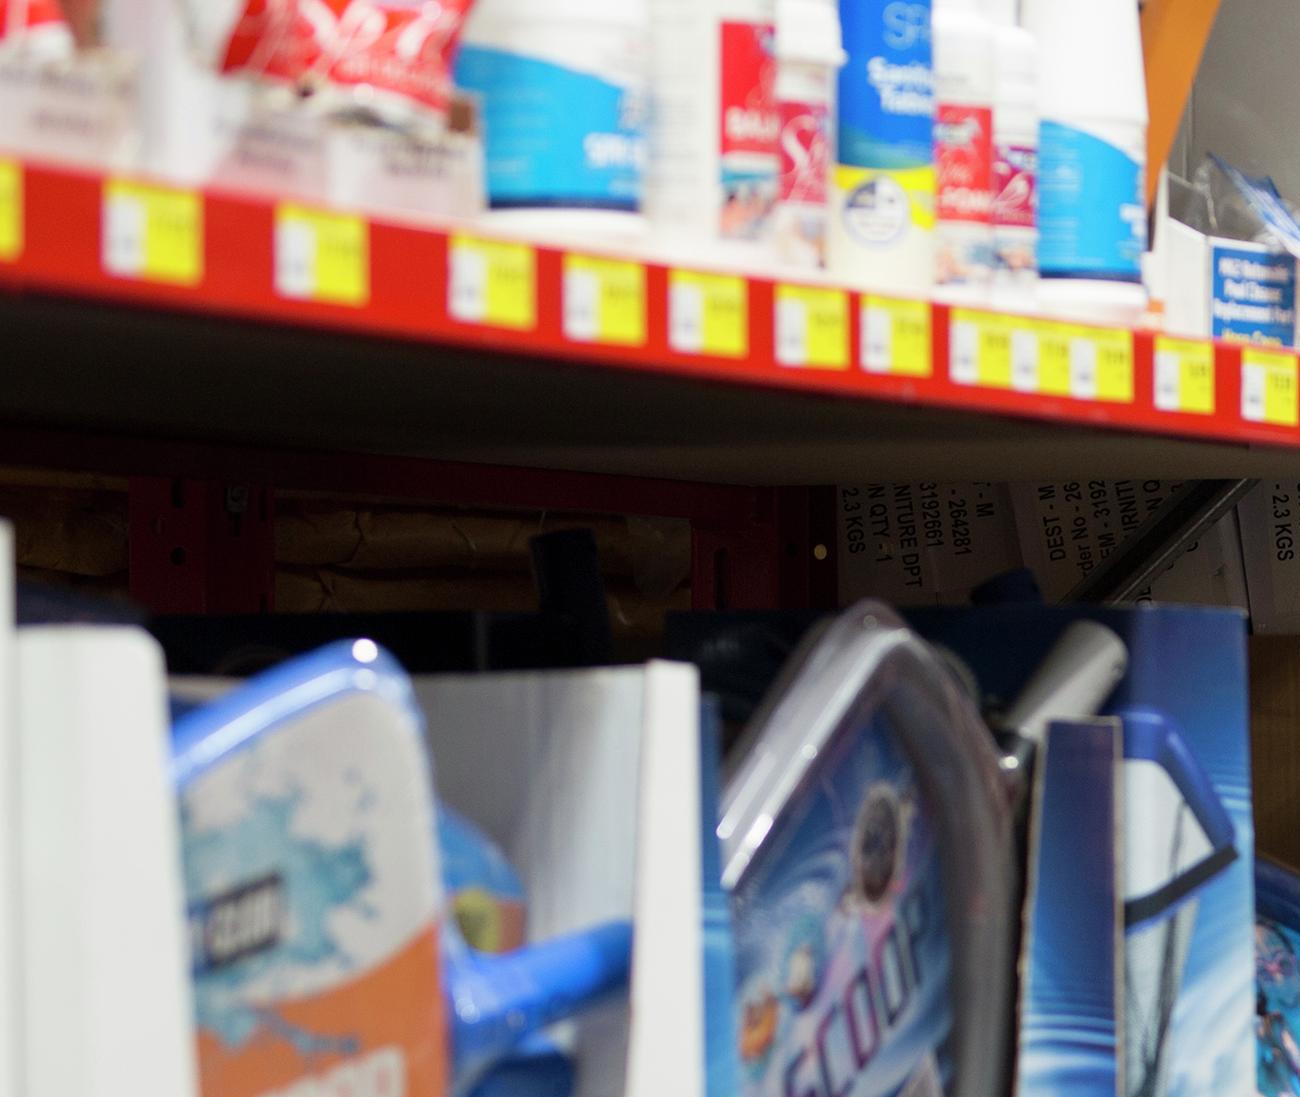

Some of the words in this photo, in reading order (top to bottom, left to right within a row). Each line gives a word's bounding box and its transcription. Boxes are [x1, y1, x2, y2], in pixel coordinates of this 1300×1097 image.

[870, 504, 890, 538] QTY
[1272, 494, 1290, 519] 2.3
[845, 516, 866, 555] KGS
[1043, 515, 1066, 561] DEST
[1072, 516, 1088, 541] No
[1275, 525, 1294, 561] KGS
[902, 556, 923, 588] DPT
